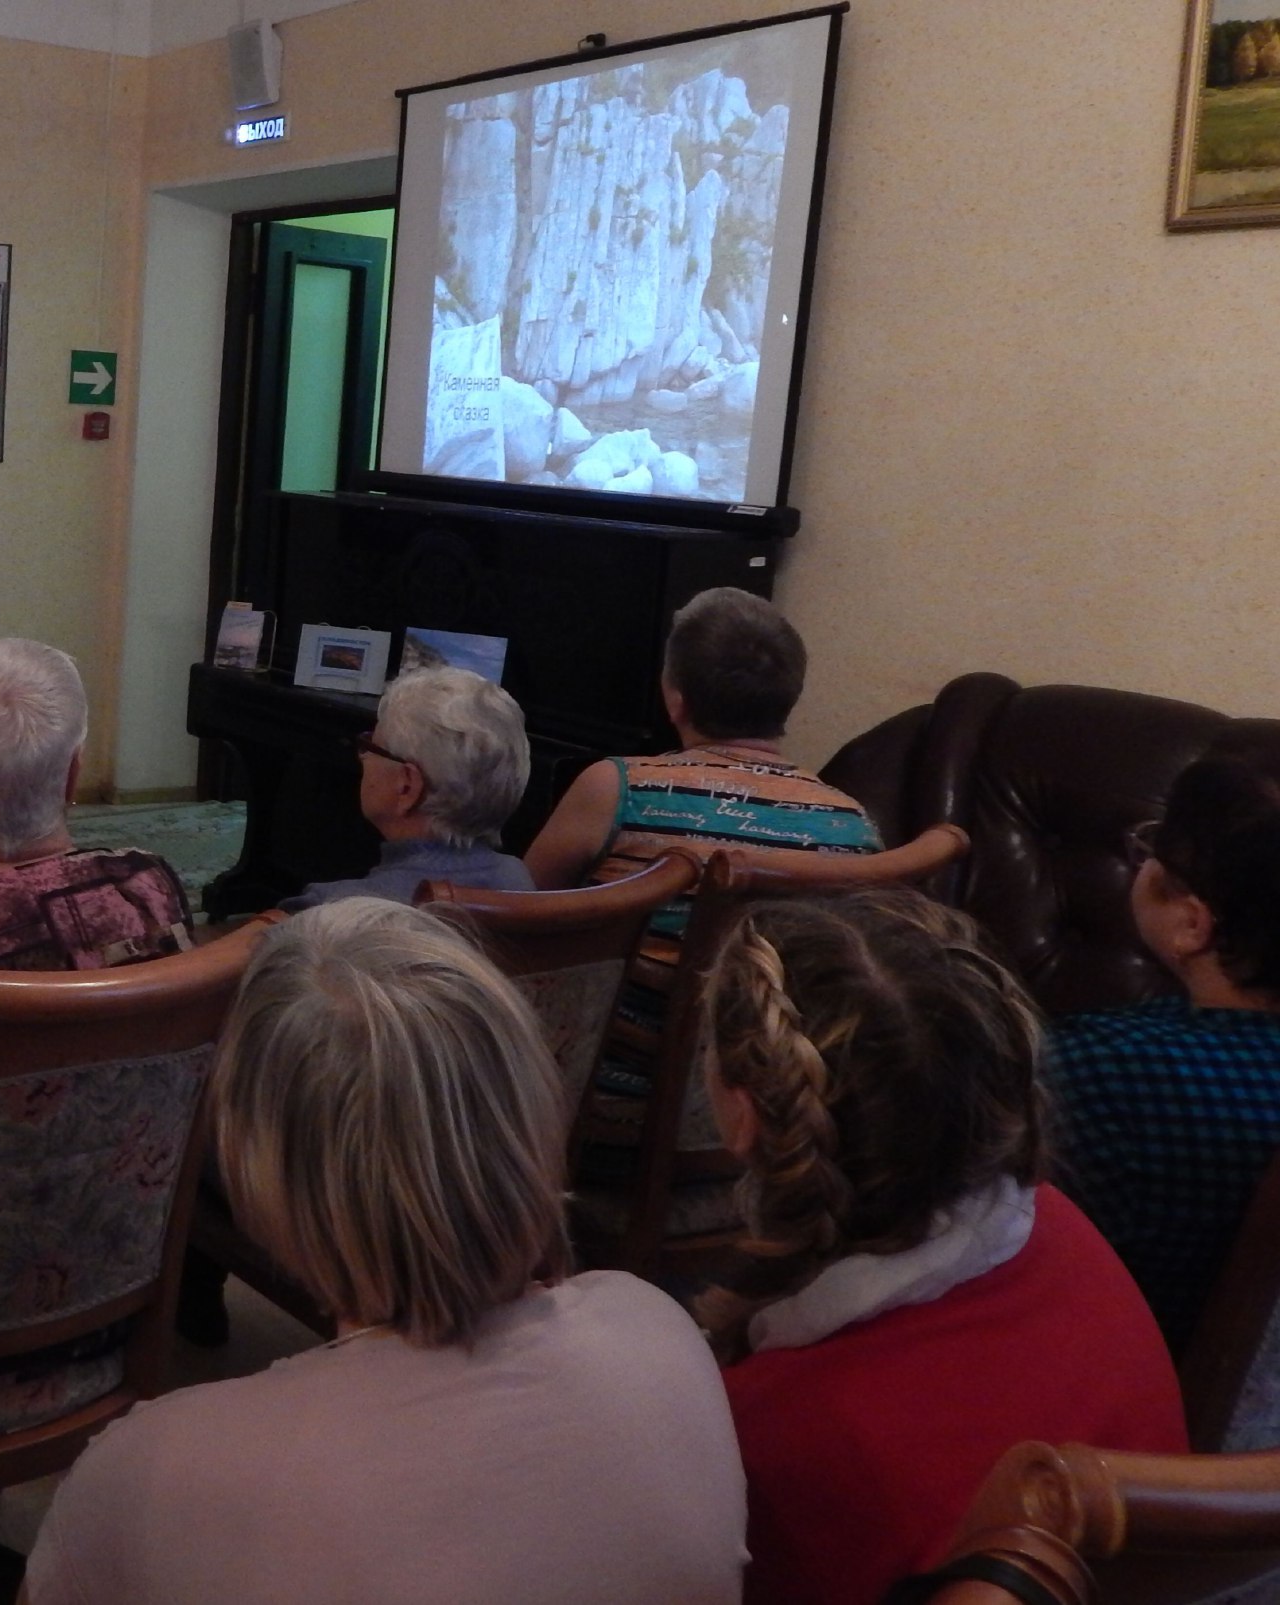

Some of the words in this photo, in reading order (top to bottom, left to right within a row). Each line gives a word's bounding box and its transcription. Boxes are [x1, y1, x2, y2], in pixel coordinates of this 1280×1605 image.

[238, 118, 284, 143] ВЫХОД
[443, 372, 500, 393] Каменная
[453, 404, 490, 421] сказка
